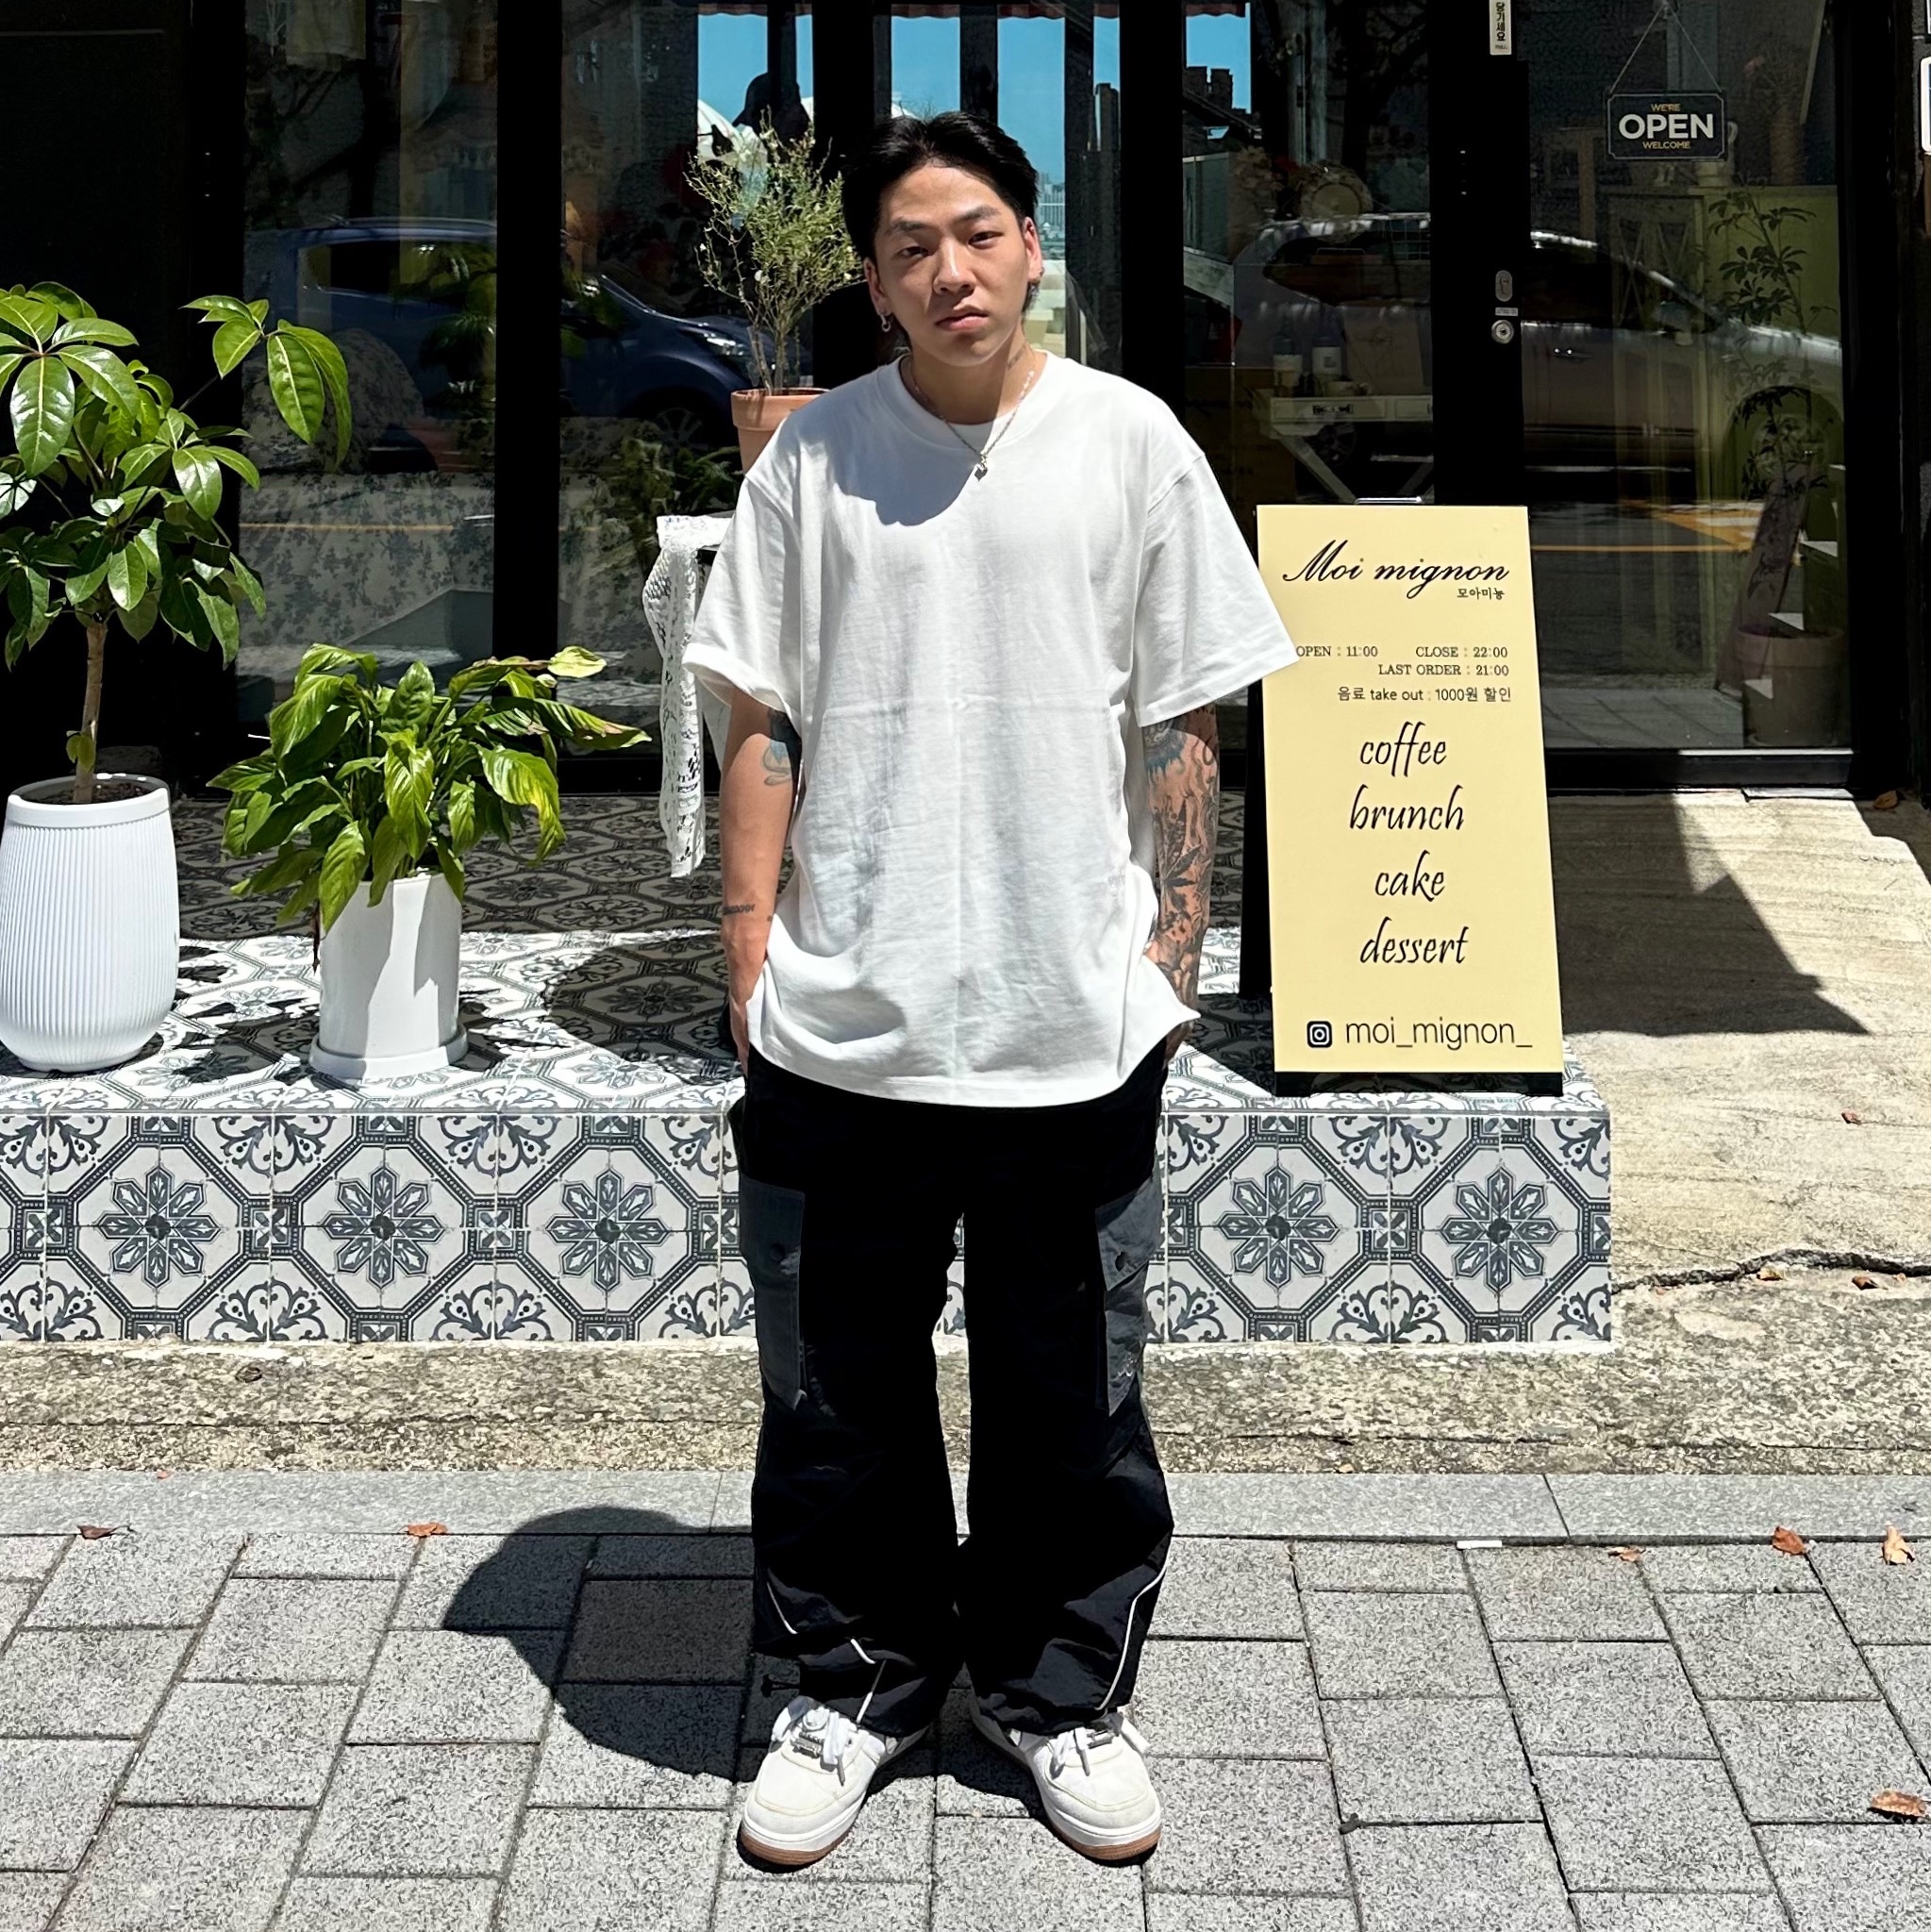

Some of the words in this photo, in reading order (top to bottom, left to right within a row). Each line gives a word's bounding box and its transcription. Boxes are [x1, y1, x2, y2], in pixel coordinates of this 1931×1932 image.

[1495, 2, 1507, 42] 당기세요
[1650, 103, 1681, 112] WE'RE
[1618, 113, 1714, 140] OPEN
[1642, 141, 1691, 150] WELCOME
[1282, 540, 1364, 582] Moi
[1373, 558, 1509, 600] mignon
[1296, 645, 1332, 657] OPEN
[1346, 645, 1378, 658] 11:00
[1415, 646, 1458, 658] CLOSE
[1473, 646, 1508, 658] 22:00
[1378, 664, 1412, 675] LAST
[1416, 664, 1461, 675] ORDER
[1475, 664, 1509, 676] 21:00
[1338, 686, 1366, 701] 음료
[1370, 688, 1398, 701] take
[1401, 690, 1423, 701] out
[1435, 687, 1478, 702] 1000원
[1484, 687, 1511, 703] 할인
[1359, 721, 1447, 777] coffee
[1349, 784, 1464, 830] brunch
[1374, 849, 1445, 902] cake
[1359, 916, 1469, 964] dessert
[1345, 1016, 1534, 1051] moi_mignon_
